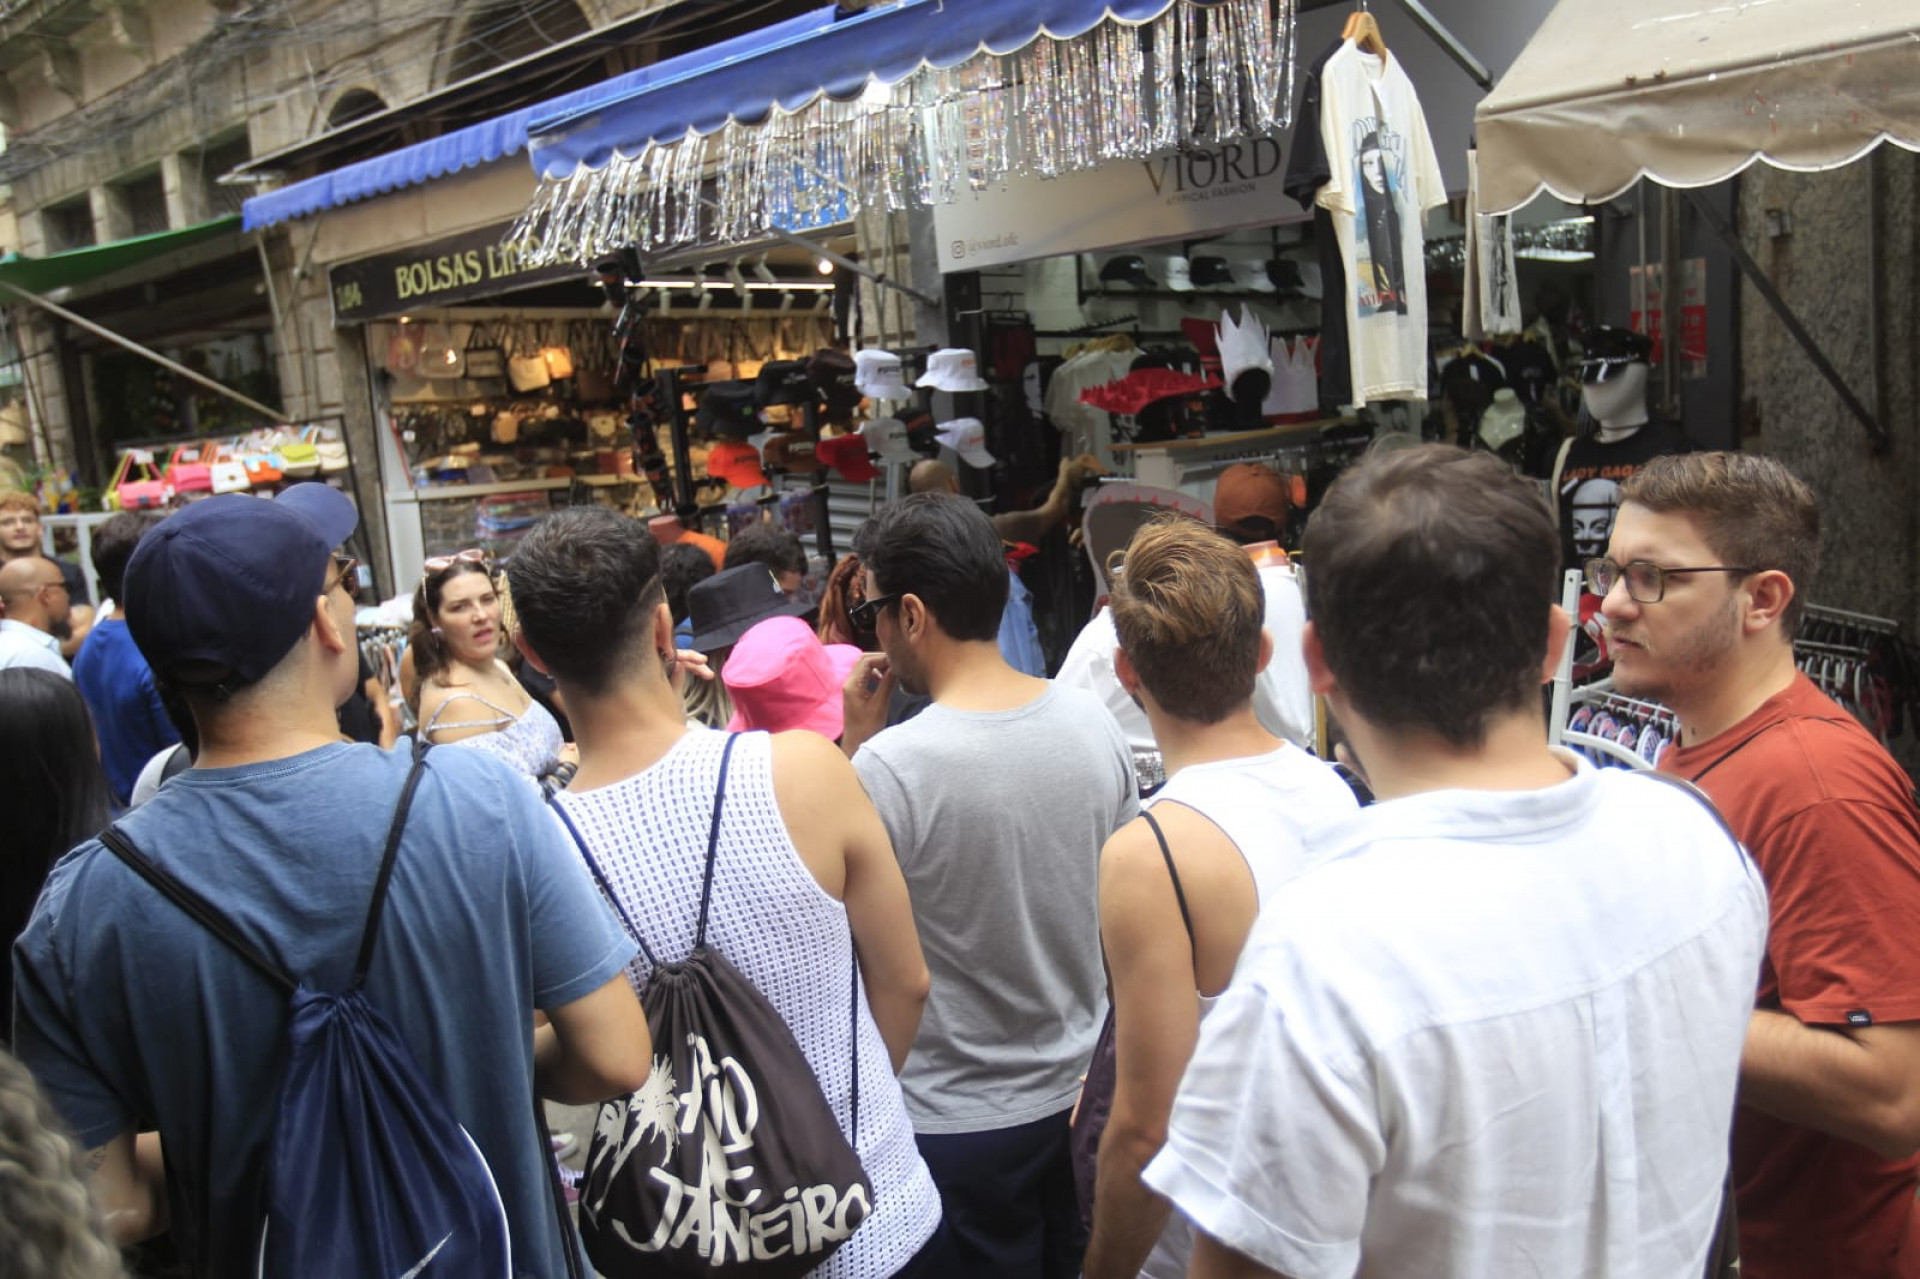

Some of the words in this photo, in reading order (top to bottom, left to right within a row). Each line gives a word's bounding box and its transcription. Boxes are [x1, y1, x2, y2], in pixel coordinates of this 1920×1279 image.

[1142, 137, 1282, 195] VIORD
[1212, 182, 1256, 199] FASHION
[395, 250, 482, 299] BOLSAS
